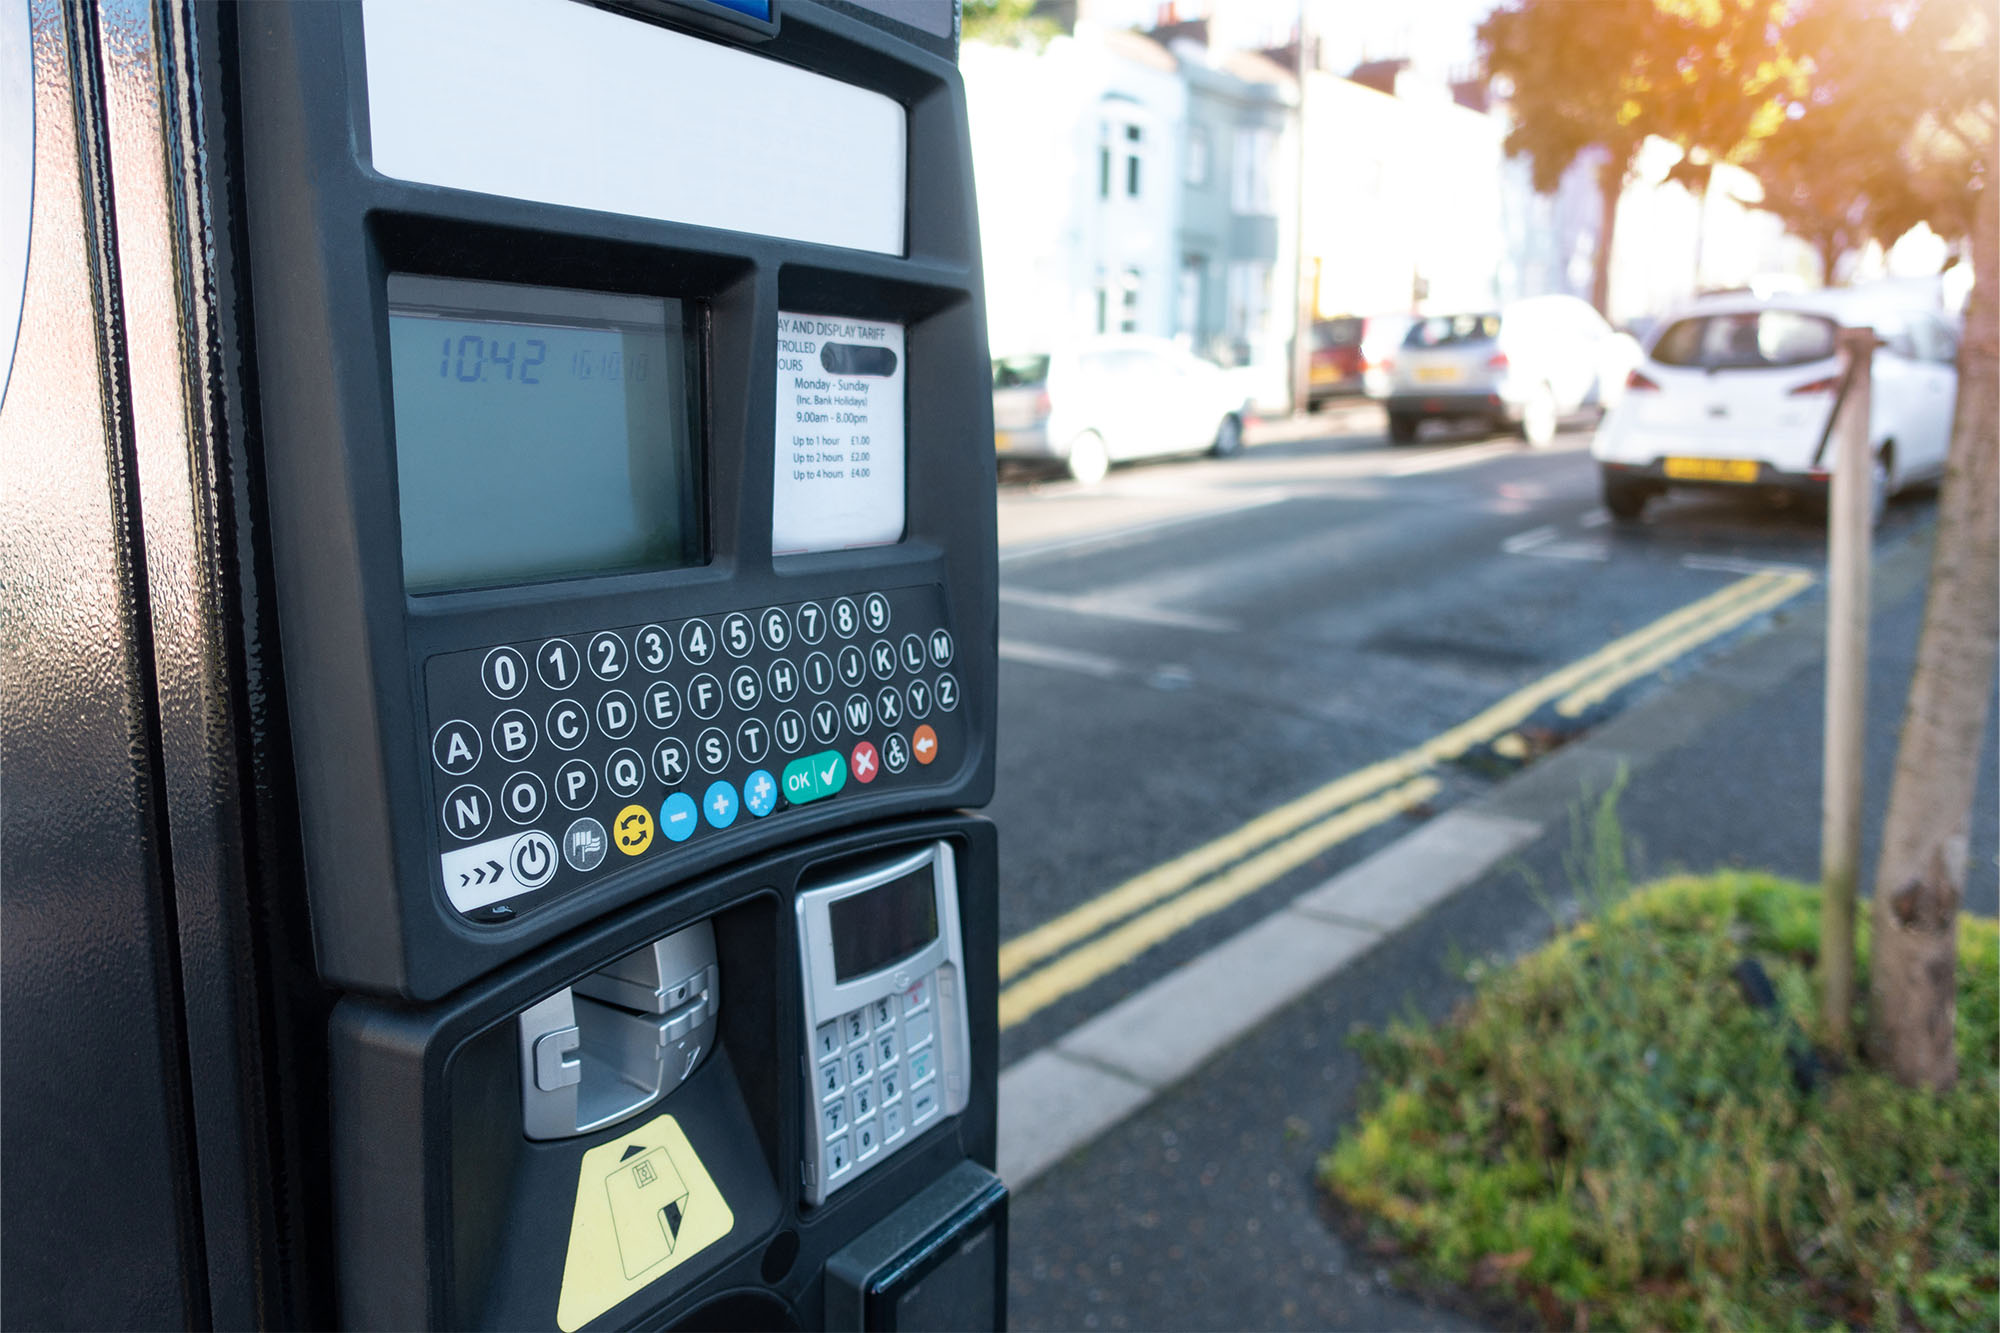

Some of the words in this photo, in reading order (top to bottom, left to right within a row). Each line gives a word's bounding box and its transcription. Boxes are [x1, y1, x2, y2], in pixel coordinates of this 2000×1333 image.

[792, 320, 814, 334] AND
[816, 322, 856, 338] DISPLAY
[857, 327, 886, 340] TARIFF
[778, 358, 803, 371] OURS
[795, 378, 831, 393] Monday
[838, 379, 870, 394] Sunday
[814, 395, 832, 406] Bank
[834, 396, 868, 408] Holidays)
[796, 411, 828, 423] 9.00am
[836, 412, 868, 425] 8.00pm
[793, 436, 805, 447] Up
[806, 436, 814, 446] to
[816, 436, 820, 446] 1
[822, 436, 840, 446] hour
[851, 436, 870, 446] £1.00
[793, 453, 805, 464] Up
[806, 453, 815, 463] to
[816, 453, 821, 463] 2
[822, 453, 843, 463] hours
[851, 452, 870, 462] £2.00
[793, 470, 806, 482] Up
[807, 470, 815, 480] to
[816, 470, 821, 478] 4
[823, 469, 844, 479] hours
[851, 468, 871, 478] £4.00
[494, 655, 516, 691] 0
[549, 647, 566, 681] 1
[598, 640, 619, 674] 2
[645, 632, 664, 665] 3
[689, 626, 707, 657] 4
[730, 619, 747, 650] 5
[768, 614, 785, 644] 6
[803, 609, 817, 638] 7
[838, 604, 853, 632] 8
[869, 599, 884, 627] 9
[447, 732, 473, 765] A
[502, 720, 527, 752] B
[557, 710, 579, 739] C
[606, 701, 627, 730] D
[653, 691, 673, 719] E
[697, 682, 712, 710] F
[736, 675, 756, 701] G
[774, 667, 792, 694] H
[814, 661, 823, 685] I
[846, 654, 858, 678] J
[876, 647, 892, 672] K
[907, 643, 921, 665] L
[933, 636, 949, 660] M
[455, 795, 481, 829] N
[512, 783, 537, 813] O
[566, 770, 586, 801] P
[614, 758, 639, 787] Q
[661, 748, 683, 776] R
[705, 737, 722, 764] S
[744, 727, 760, 753] T
[782, 718, 799, 744] U
[816, 710, 832, 735] V
[847, 701, 867, 727] W
[882, 694, 898, 719] X
[911, 687, 925, 711] Y
[941, 681, 954, 704] Z
[787, 770, 811, 792] OK
[825, 1036, 831, 1051] 1
[853, 1022, 860, 1036] 2
[881, 1007, 887, 1021] 3
[828, 1076, 835, 1089] 4
[857, 1060, 864, 1075] 5
[884, 1045, 891, 1059] 6
[831, 1115, 838, 1129] 7
[860, 1098, 867, 1112] 8
[887, 1082, 894, 1096] 9
[863, 1132, 870, 1147] 0
